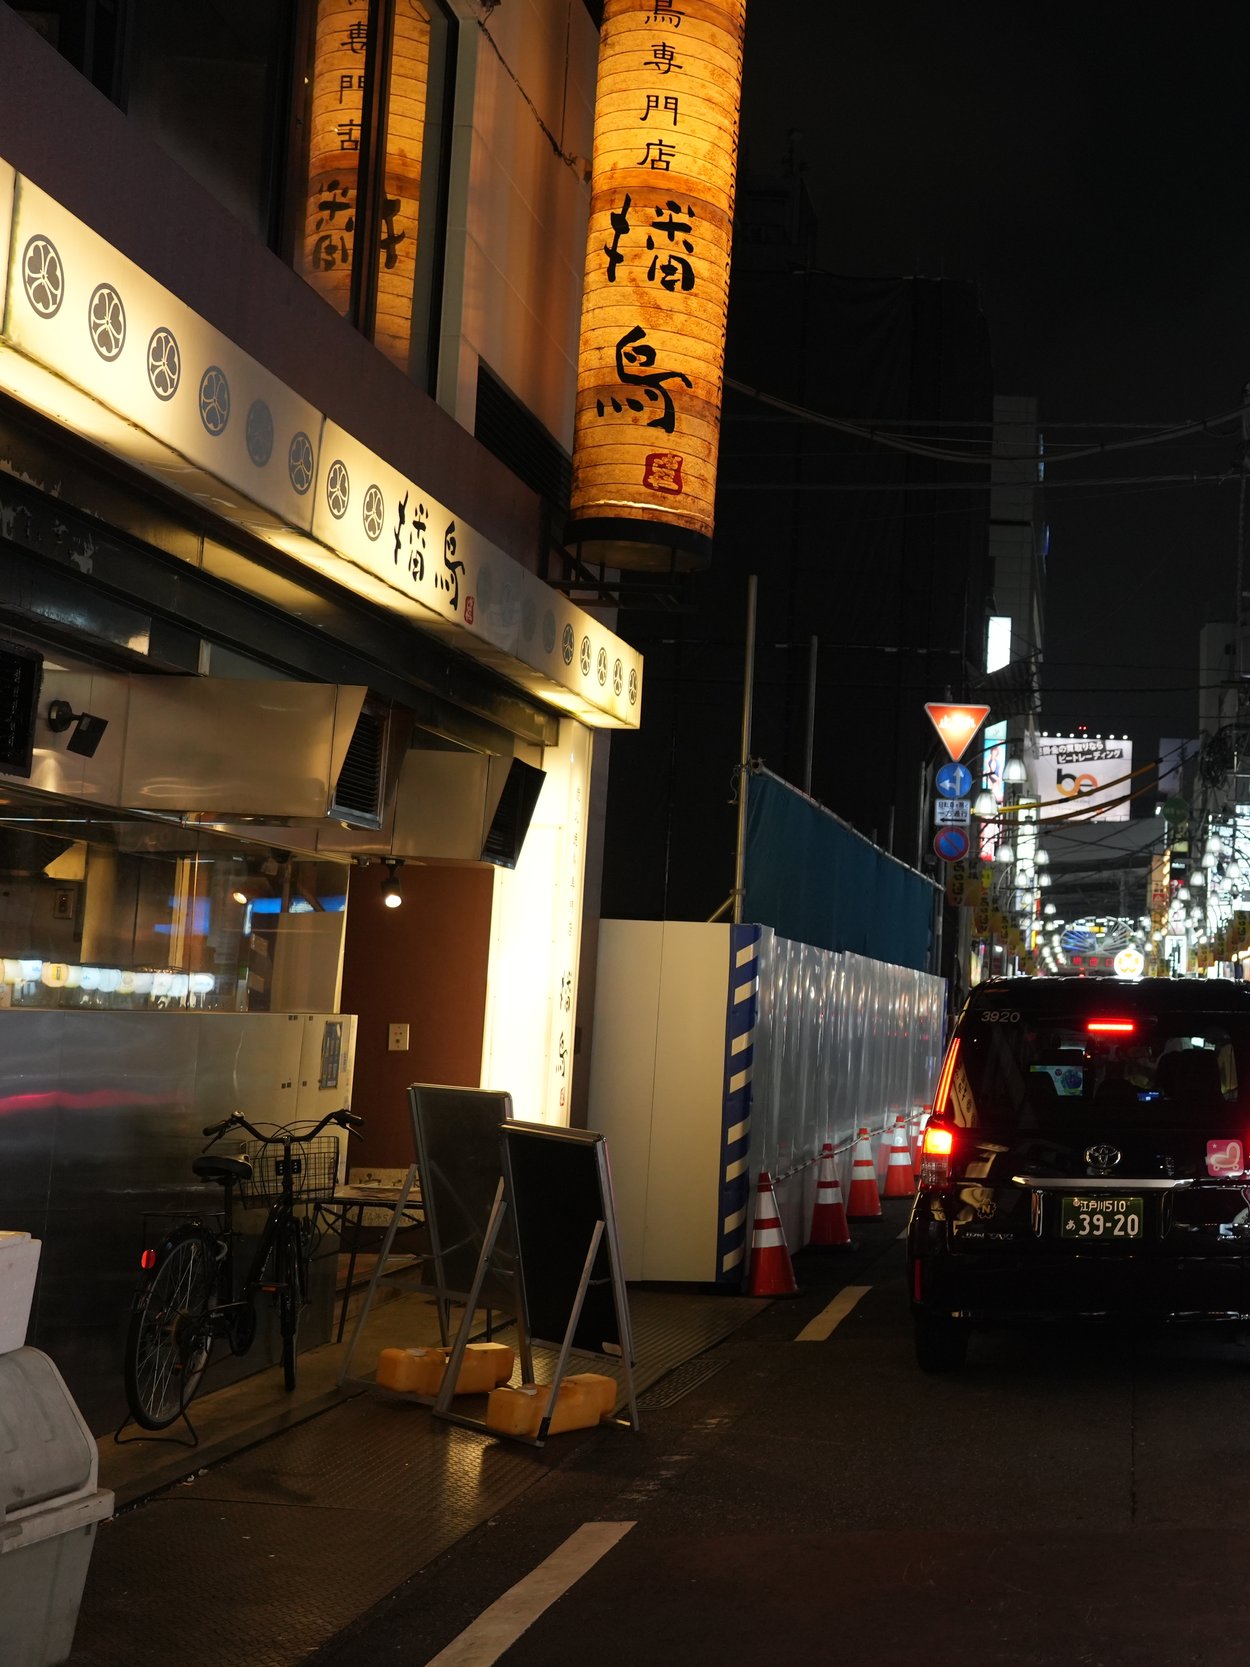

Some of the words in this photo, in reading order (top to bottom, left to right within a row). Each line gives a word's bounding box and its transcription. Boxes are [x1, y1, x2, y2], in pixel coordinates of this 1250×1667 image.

[1039, 741, 1104, 756] 掛金の買取りなら
[1058, 750, 1121, 764] ビートレーディング
[981, 1011, 1021, 1023] 3920
[1065, 1219, 1077, 1230] あ
[1078, 1214, 1139, 1236] 39-20
